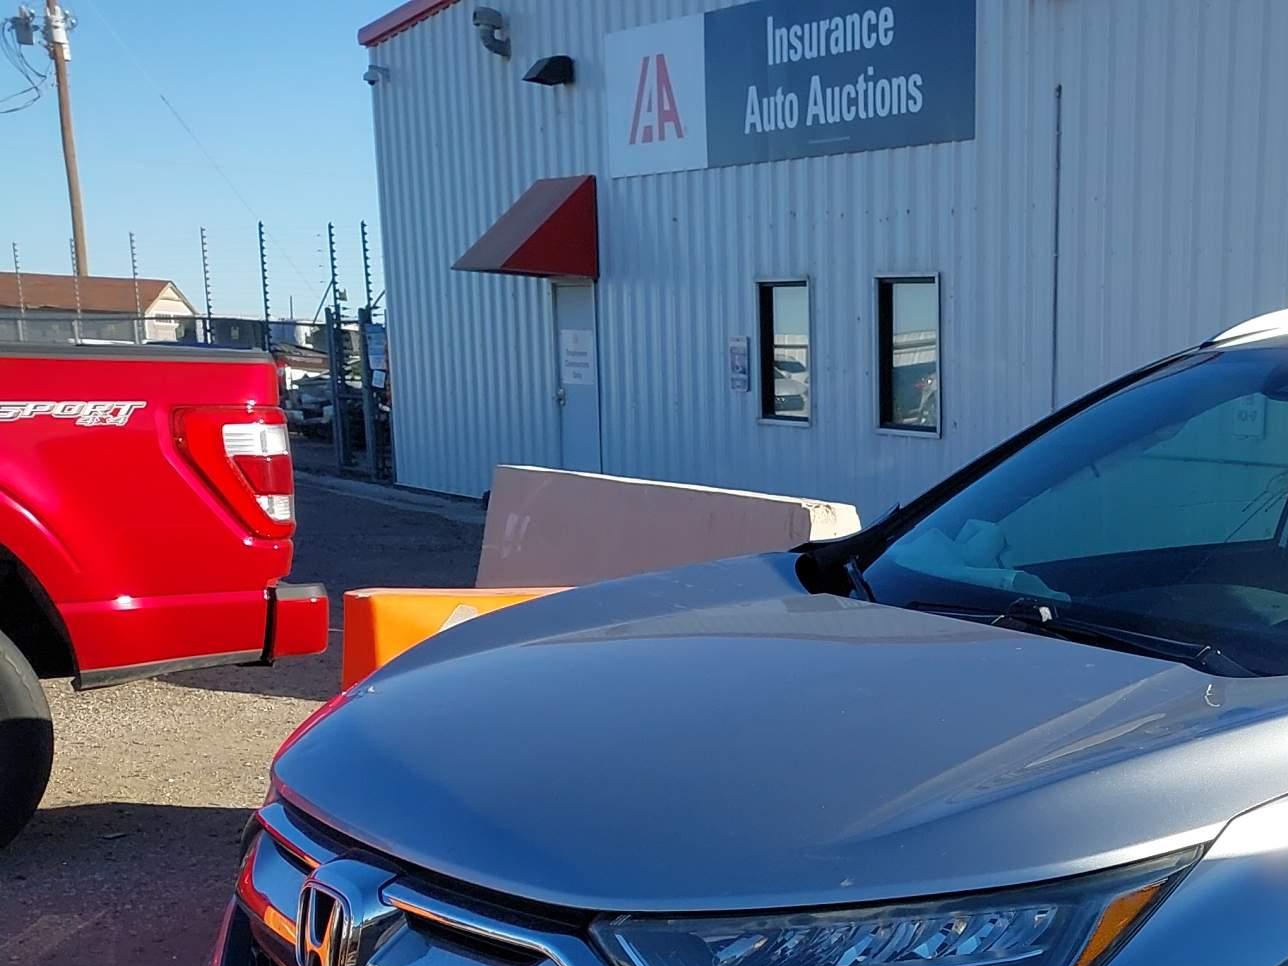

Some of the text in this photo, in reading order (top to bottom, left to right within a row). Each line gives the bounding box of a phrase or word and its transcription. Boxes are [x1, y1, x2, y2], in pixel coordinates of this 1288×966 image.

[767, 6, 894, 65] Insurance
[744, 66, 924, 135] Auto Auctions
